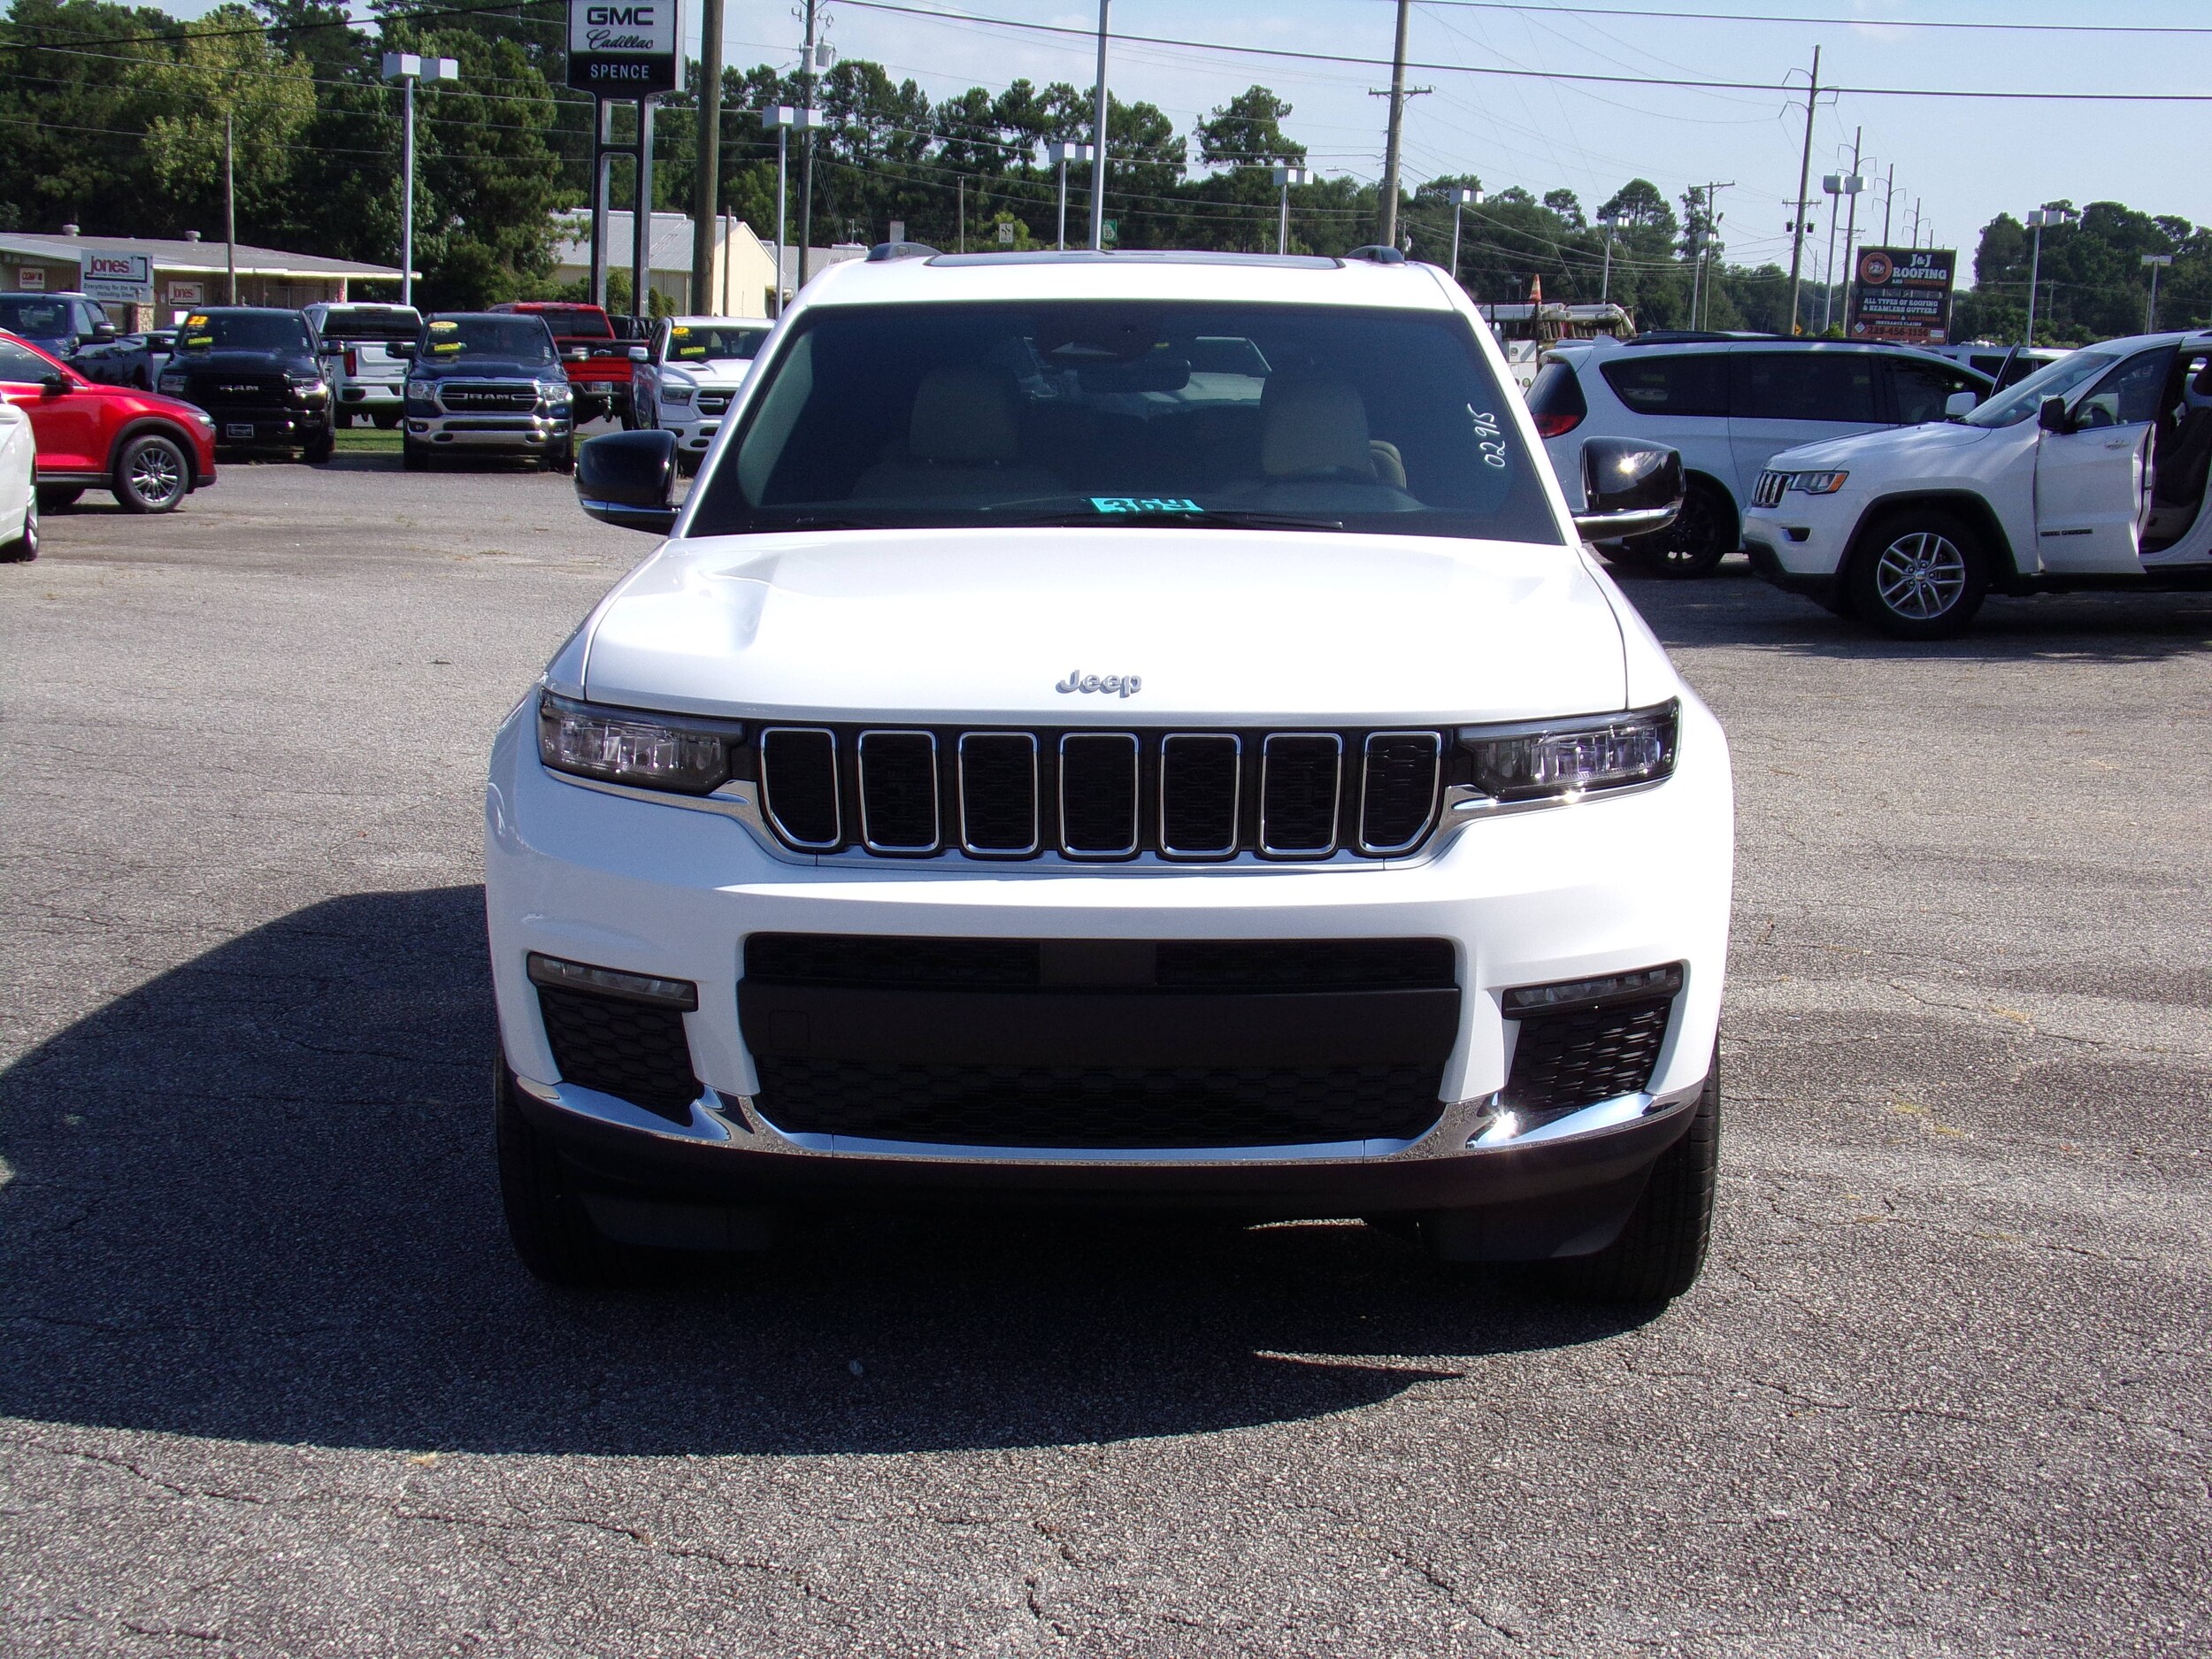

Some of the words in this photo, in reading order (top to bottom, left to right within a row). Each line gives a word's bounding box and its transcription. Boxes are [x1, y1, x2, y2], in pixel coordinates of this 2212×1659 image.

[587, 6, 654, 26] GMC
[586, 28, 654, 50] Cadillac
[590, 64, 649, 79] SPENCE
[1910, 254, 1932, 267] J&J
[1893, 267, 1947, 280] ROOFING
[1055, 669, 1142, 698] Jeep
